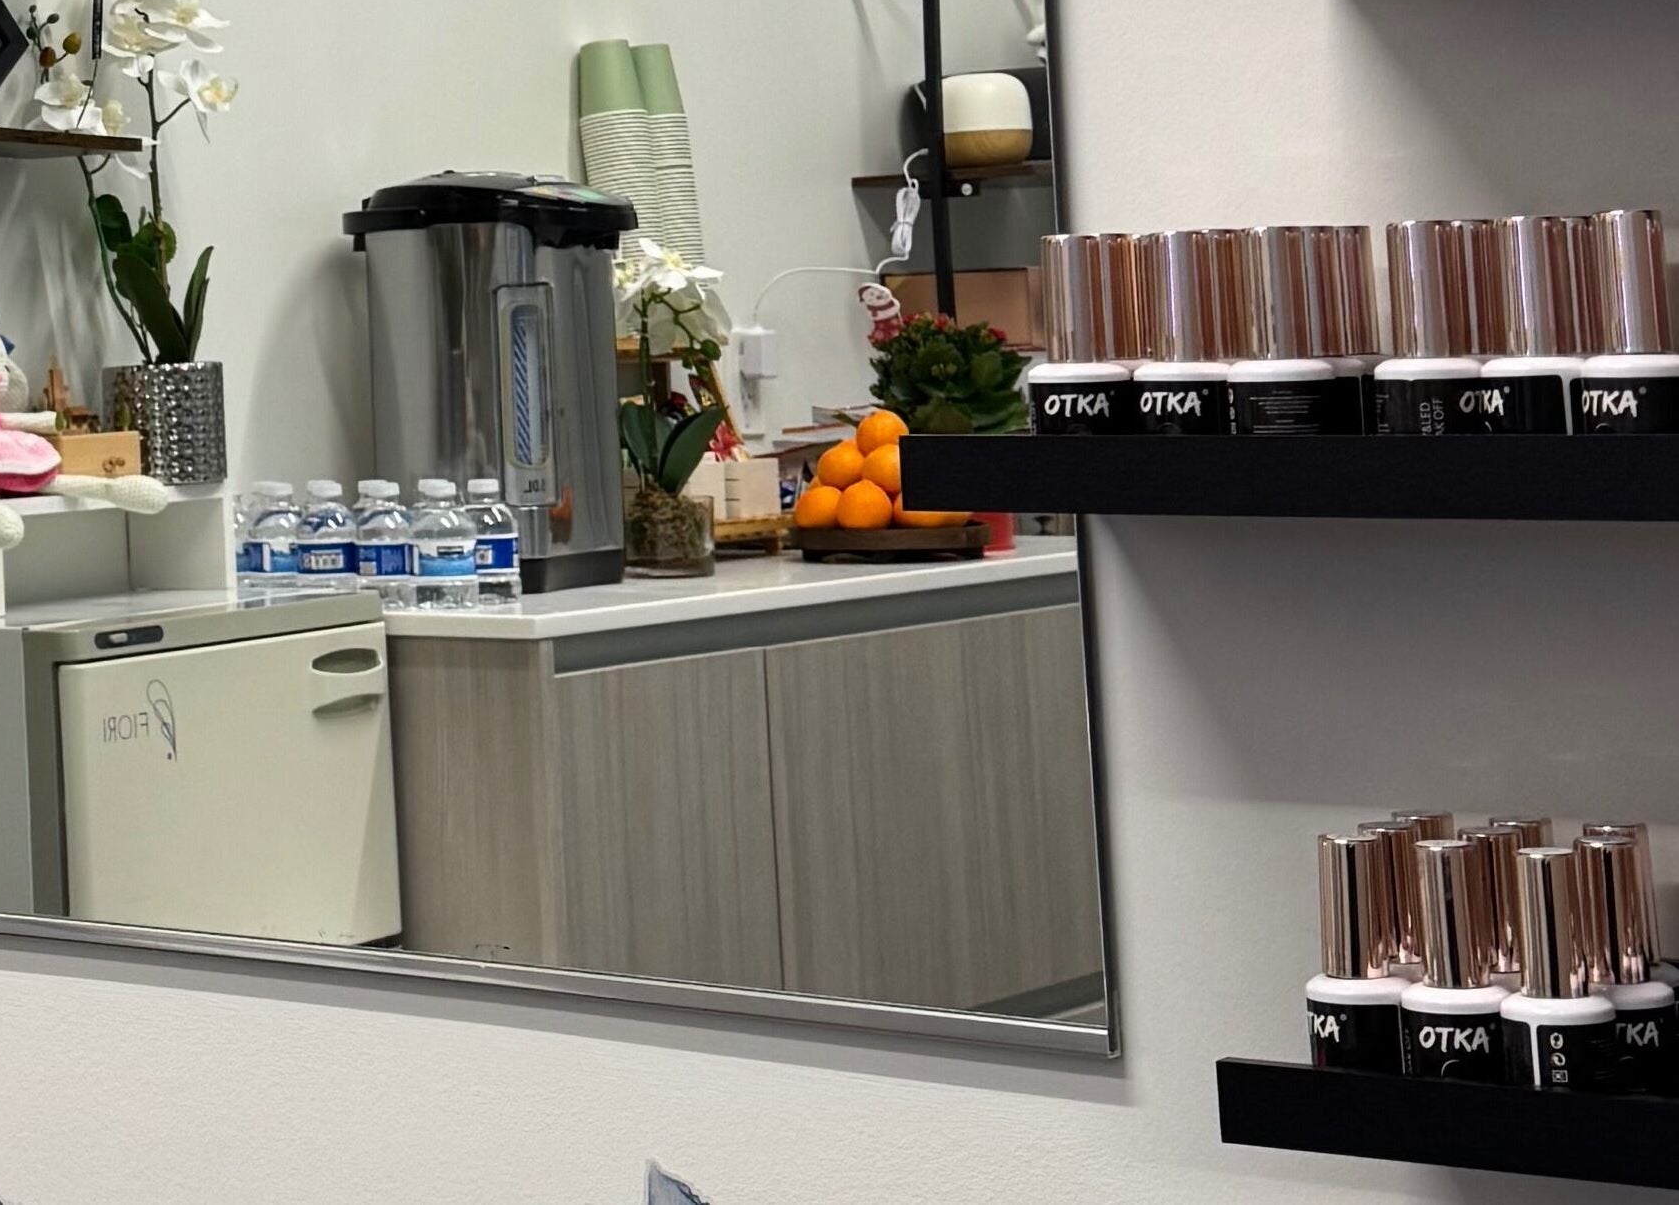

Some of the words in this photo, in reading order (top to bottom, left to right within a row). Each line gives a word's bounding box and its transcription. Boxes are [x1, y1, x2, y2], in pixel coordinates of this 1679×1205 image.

[1043, 393, 1110, 418] OTKA
[1139, 391, 1202, 417] OTKA
[1582, 390, 1638, 418] OTKA
[1418, 1025, 1490, 1054] OTKA
